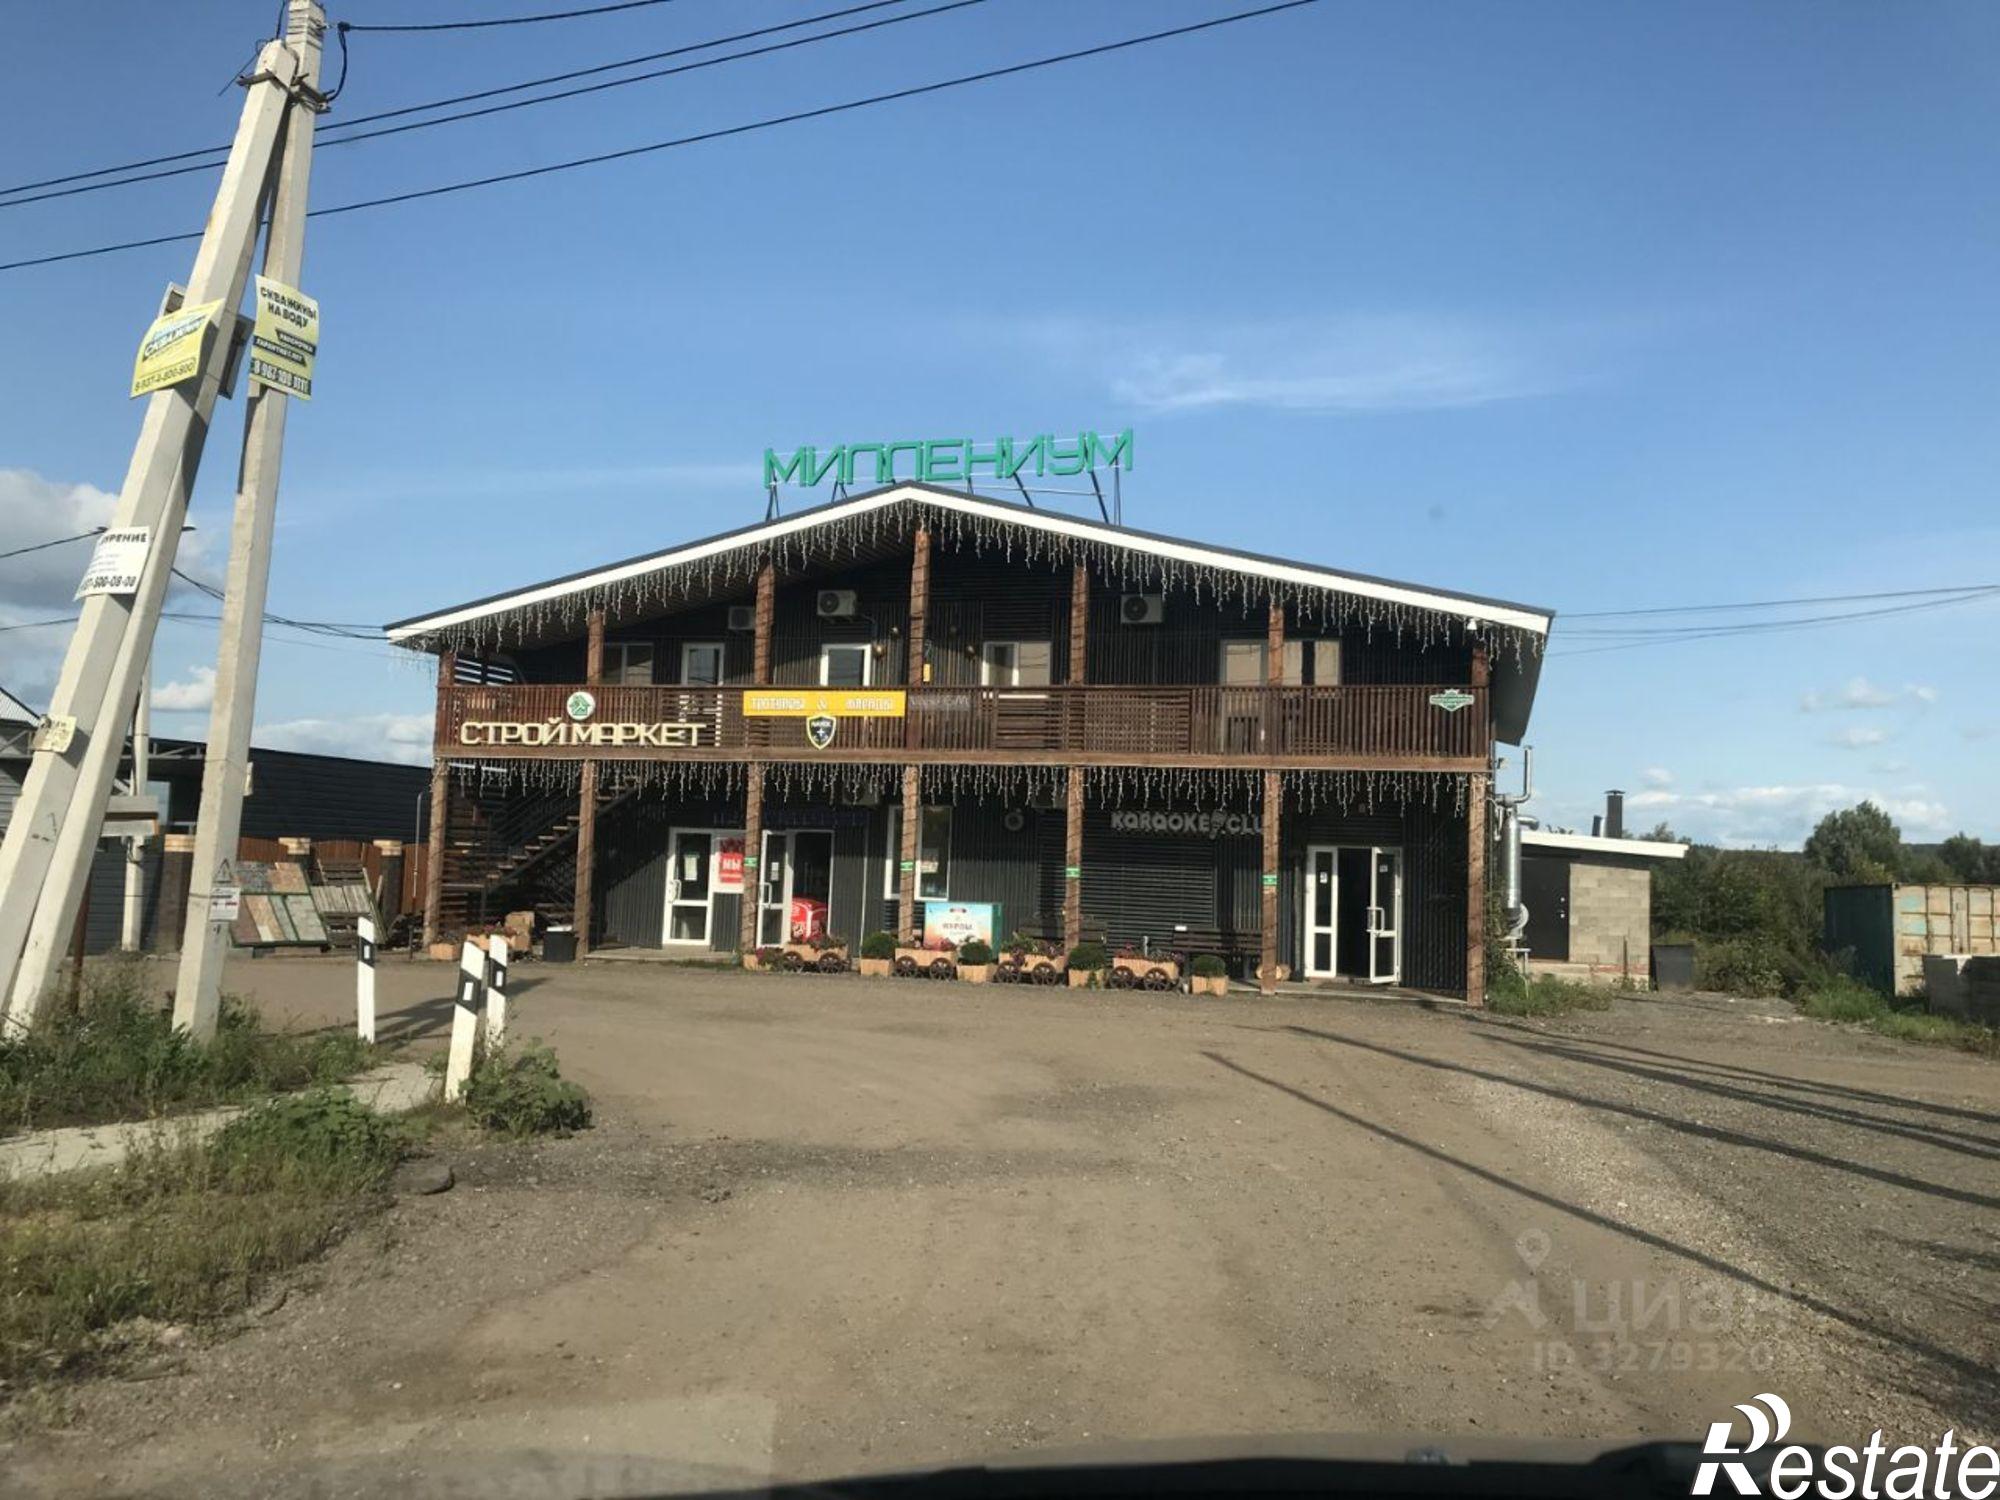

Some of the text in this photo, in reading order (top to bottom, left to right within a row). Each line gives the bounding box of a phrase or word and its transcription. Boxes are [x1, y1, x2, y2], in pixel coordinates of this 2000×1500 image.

[260, 287, 317, 320] СКВАЖИНЫ
[268, 302, 309, 328] НА ВОДУ
[100, 532, 147, 546] УРЕНИЕ
[460, 717, 708, 746] СТРОЙ МАРКЕТ
[1226, 813, 1265, 835] CLU
